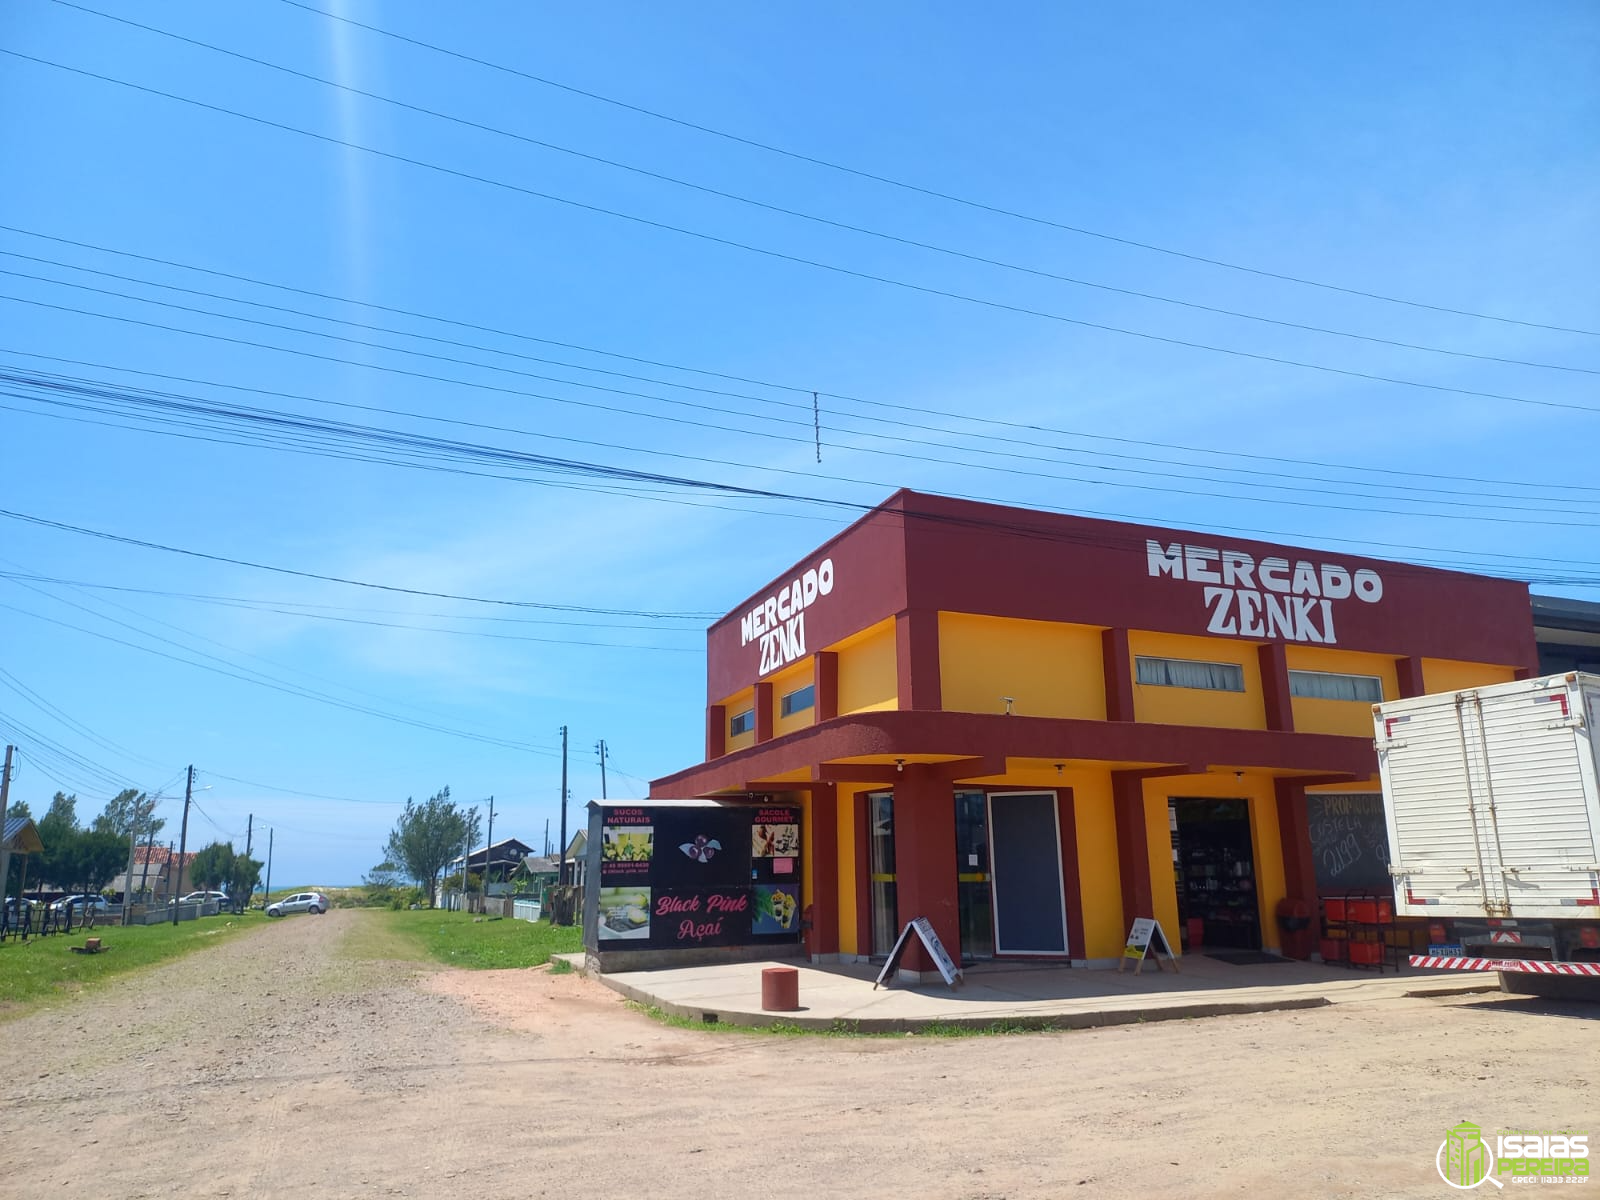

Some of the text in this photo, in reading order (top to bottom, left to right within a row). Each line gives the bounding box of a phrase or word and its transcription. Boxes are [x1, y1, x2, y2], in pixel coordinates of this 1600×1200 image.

[1146, 539, 1383, 603] MERCADO
[741, 558, 834, 647] MERCADO
[1204, 587, 1337, 644] ZENKI
[759, 612, 806, 676] ZENKI
[607, 816, 651, 824] NATURAIS
[613, 808, 643, 816] SUCOS
[754, 816, 794, 824] GOURMET
[655, 894, 748, 916] Black Pink
[677, 917, 725, 941] Açaí
